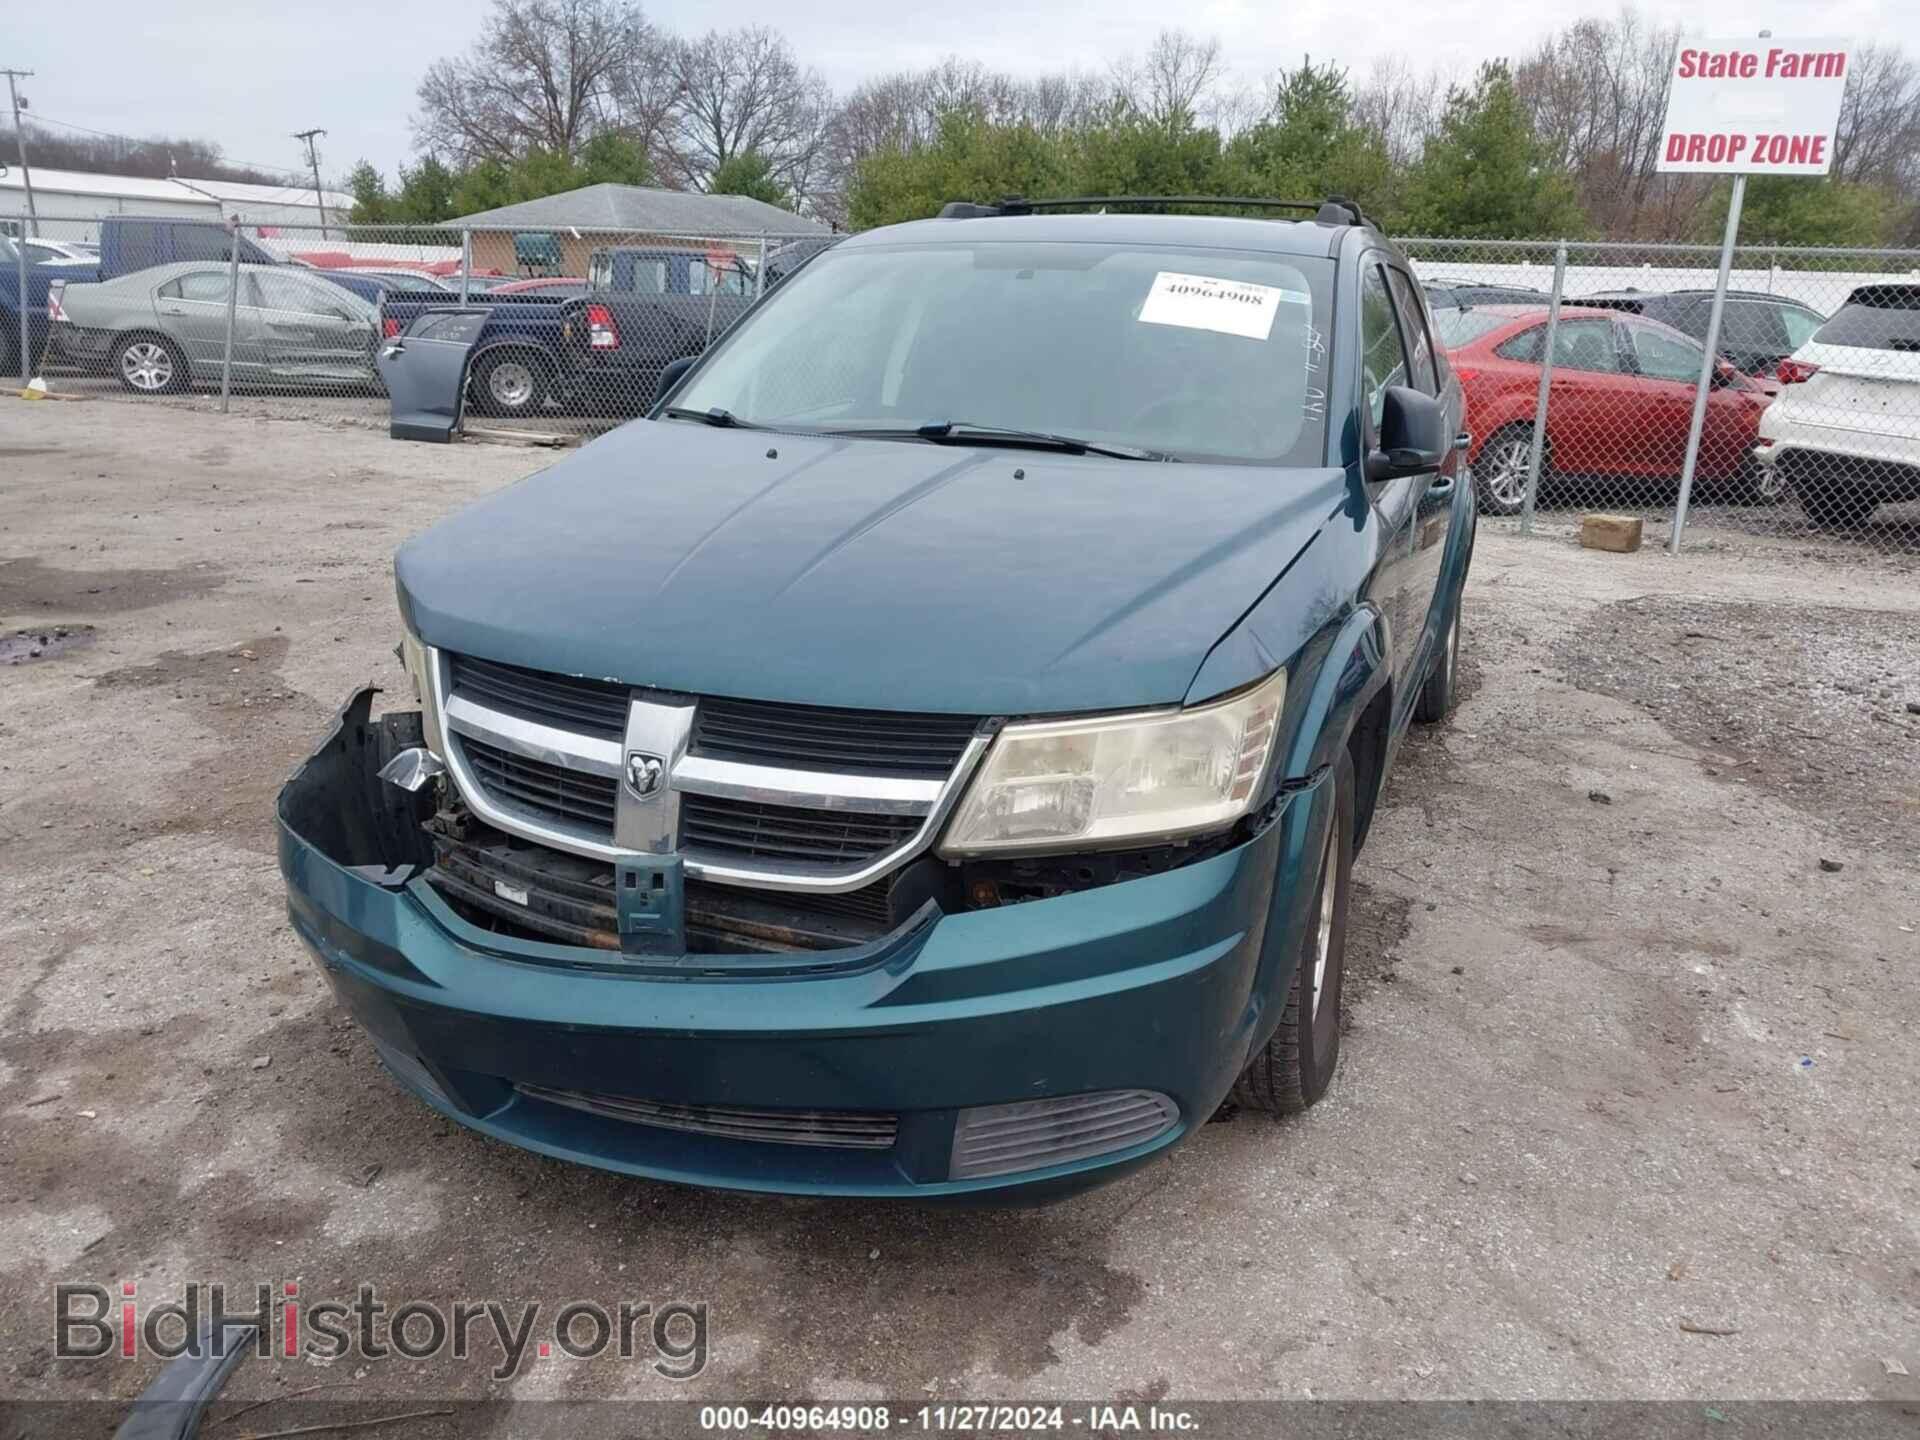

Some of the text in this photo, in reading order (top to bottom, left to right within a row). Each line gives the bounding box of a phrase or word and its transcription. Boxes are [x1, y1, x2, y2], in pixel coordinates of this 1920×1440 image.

[1678, 48, 1847, 78] State Farm
[1665, 133, 1828, 165] DROP ZONE
[1166, 283, 1264, 306] 40964908
